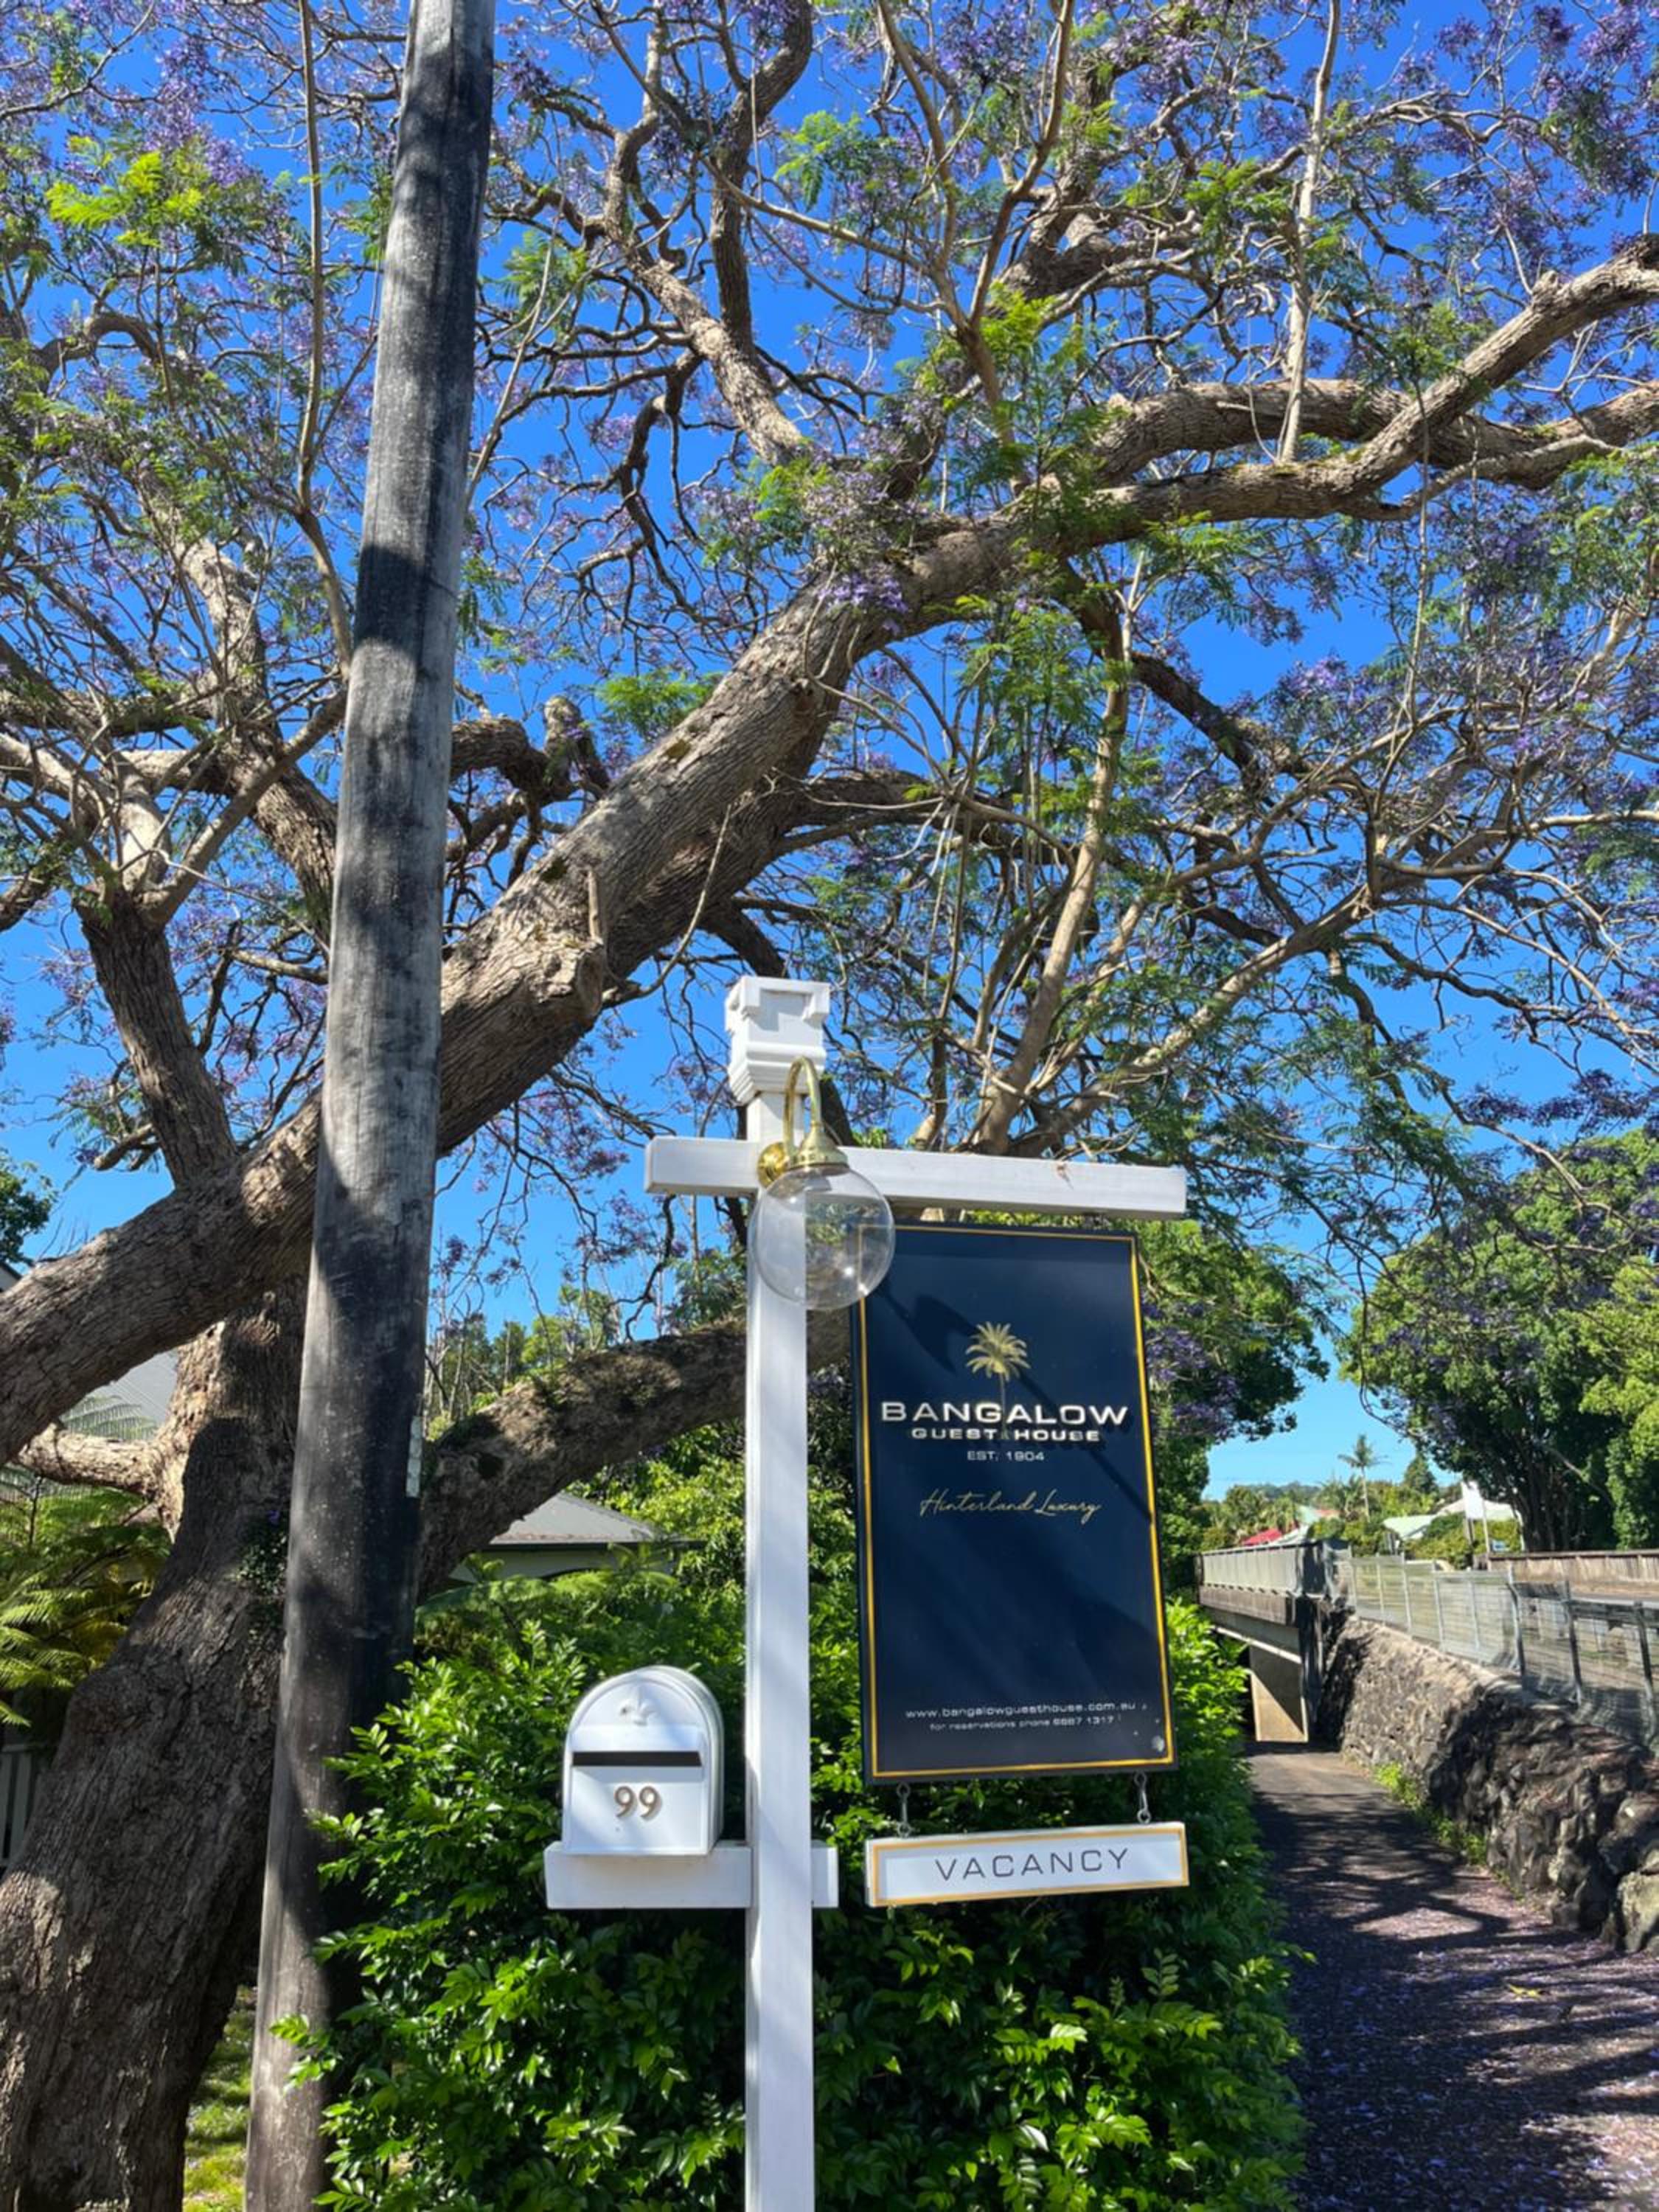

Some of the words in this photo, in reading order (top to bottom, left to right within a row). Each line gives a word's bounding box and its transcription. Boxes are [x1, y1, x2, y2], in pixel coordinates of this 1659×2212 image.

[881, 1402, 1128, 1425] BANGALOW
[911, 1428, 998, 1440] GUEST
[1014, 1428, 1100, 1441] HOUSE
[1006, 1451, 1045, 1461] 1904
[920, 1489, 1037, 1517] Hinterland
[1036, 1489, 1102, 1524] Luxury
[930, 1722, 946, 1731] for
[949, 1720, 1016, 1731] reservations
[613, 1786, 662, 1820] 99
[935, 1848, 1129, 1881] VACANCY
